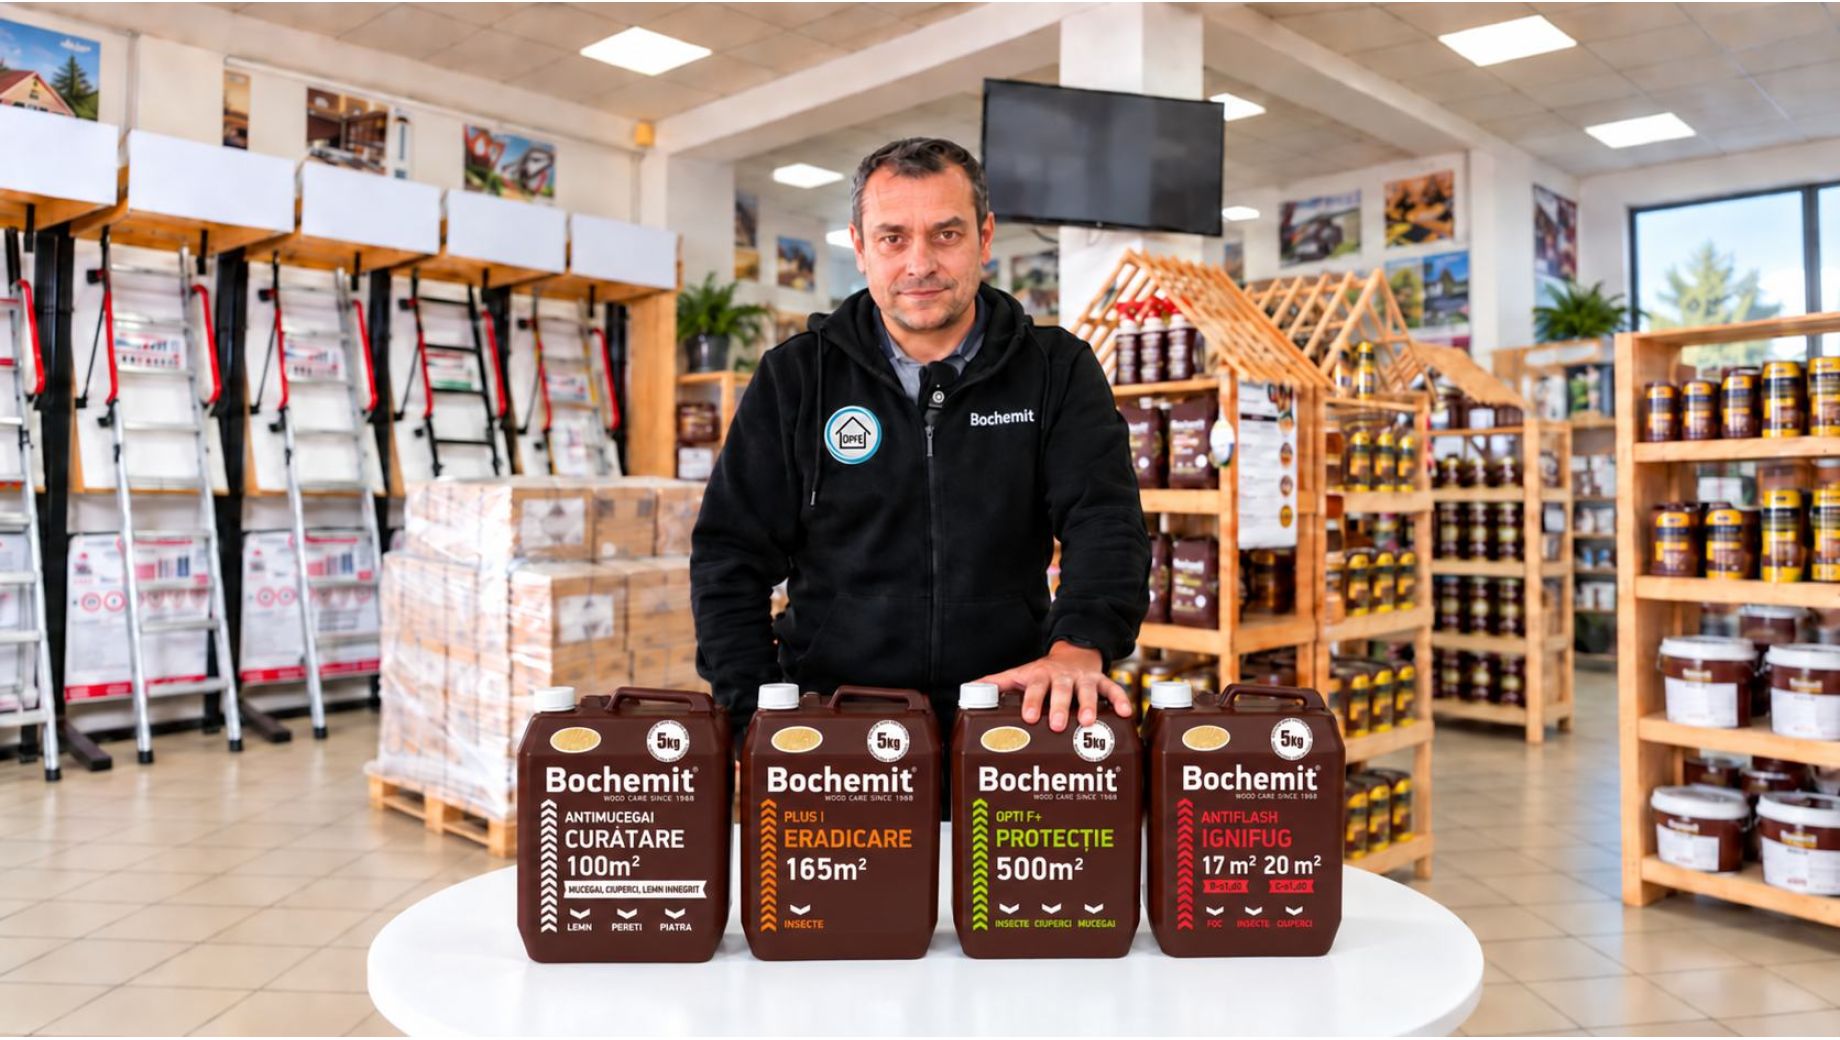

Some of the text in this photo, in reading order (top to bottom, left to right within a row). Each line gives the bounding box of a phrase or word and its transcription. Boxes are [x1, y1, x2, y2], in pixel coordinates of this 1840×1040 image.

[970, 409, 1035, 426] Bochemit
[657, 732, 680, 750] 5kg
[877, 732, 900, 750] 5kg
[1083, 732, 1106, 750] 5kg
[1280, 730, 1304, 749] 5kg
[565, 811, 654, 823] ANTIMUCEGAI
[784, 811, 817, 822] PLUS
[996, 811, 1042, 822] OPTI F+
[1201, 811, 1279, 823] ANTIFLASH
[784, 829, 912, 848] ERADICARE
[1202, 829, 1293, 848] IGNIFUG
[567, 855, 640, 876] 100m²
[786, 857, 867, 880] 165m²
[997, 856, 1084, 880] 500m²
[1202, 855, 1322, 875] 17 m² 20 m²
[643, 885, 664, 894] LEMN
[567, 923, 692, 931] LEMN PERETI PIATRA
[784, 919, 824, 929] INSECTE
[995, 919, 1030, 928] INSECTE
[1207, 919, 1223, 928] FOC
[1236, 919, 1270, 928] INSECTE
